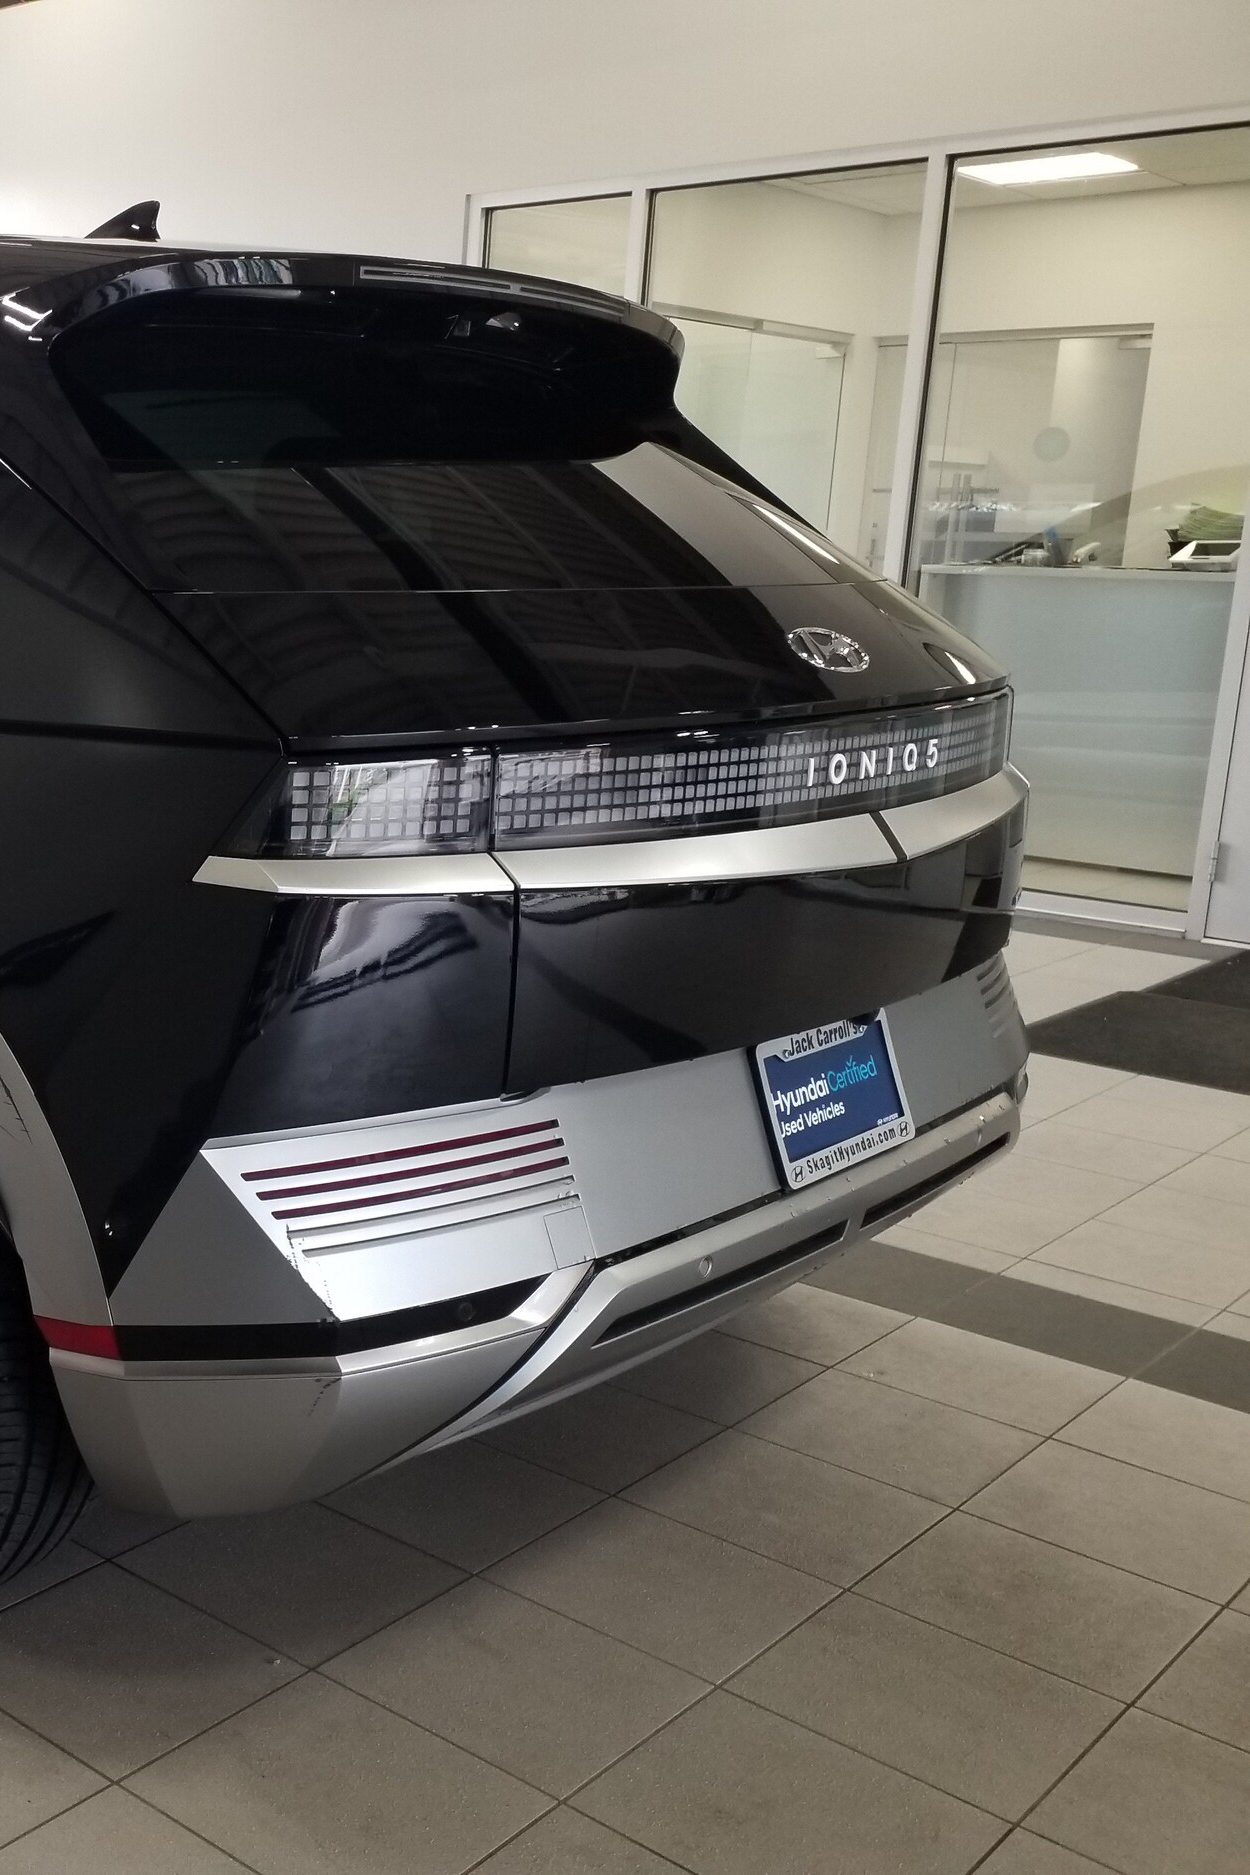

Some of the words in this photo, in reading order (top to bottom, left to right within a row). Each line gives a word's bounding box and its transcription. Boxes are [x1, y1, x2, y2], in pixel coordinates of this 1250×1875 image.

[789, 1032, 815, 1057] Jack
[804, 1101, 846, 1128] Vehicles
[806, 1125, 897, 1175] SkagitHyundai.com
